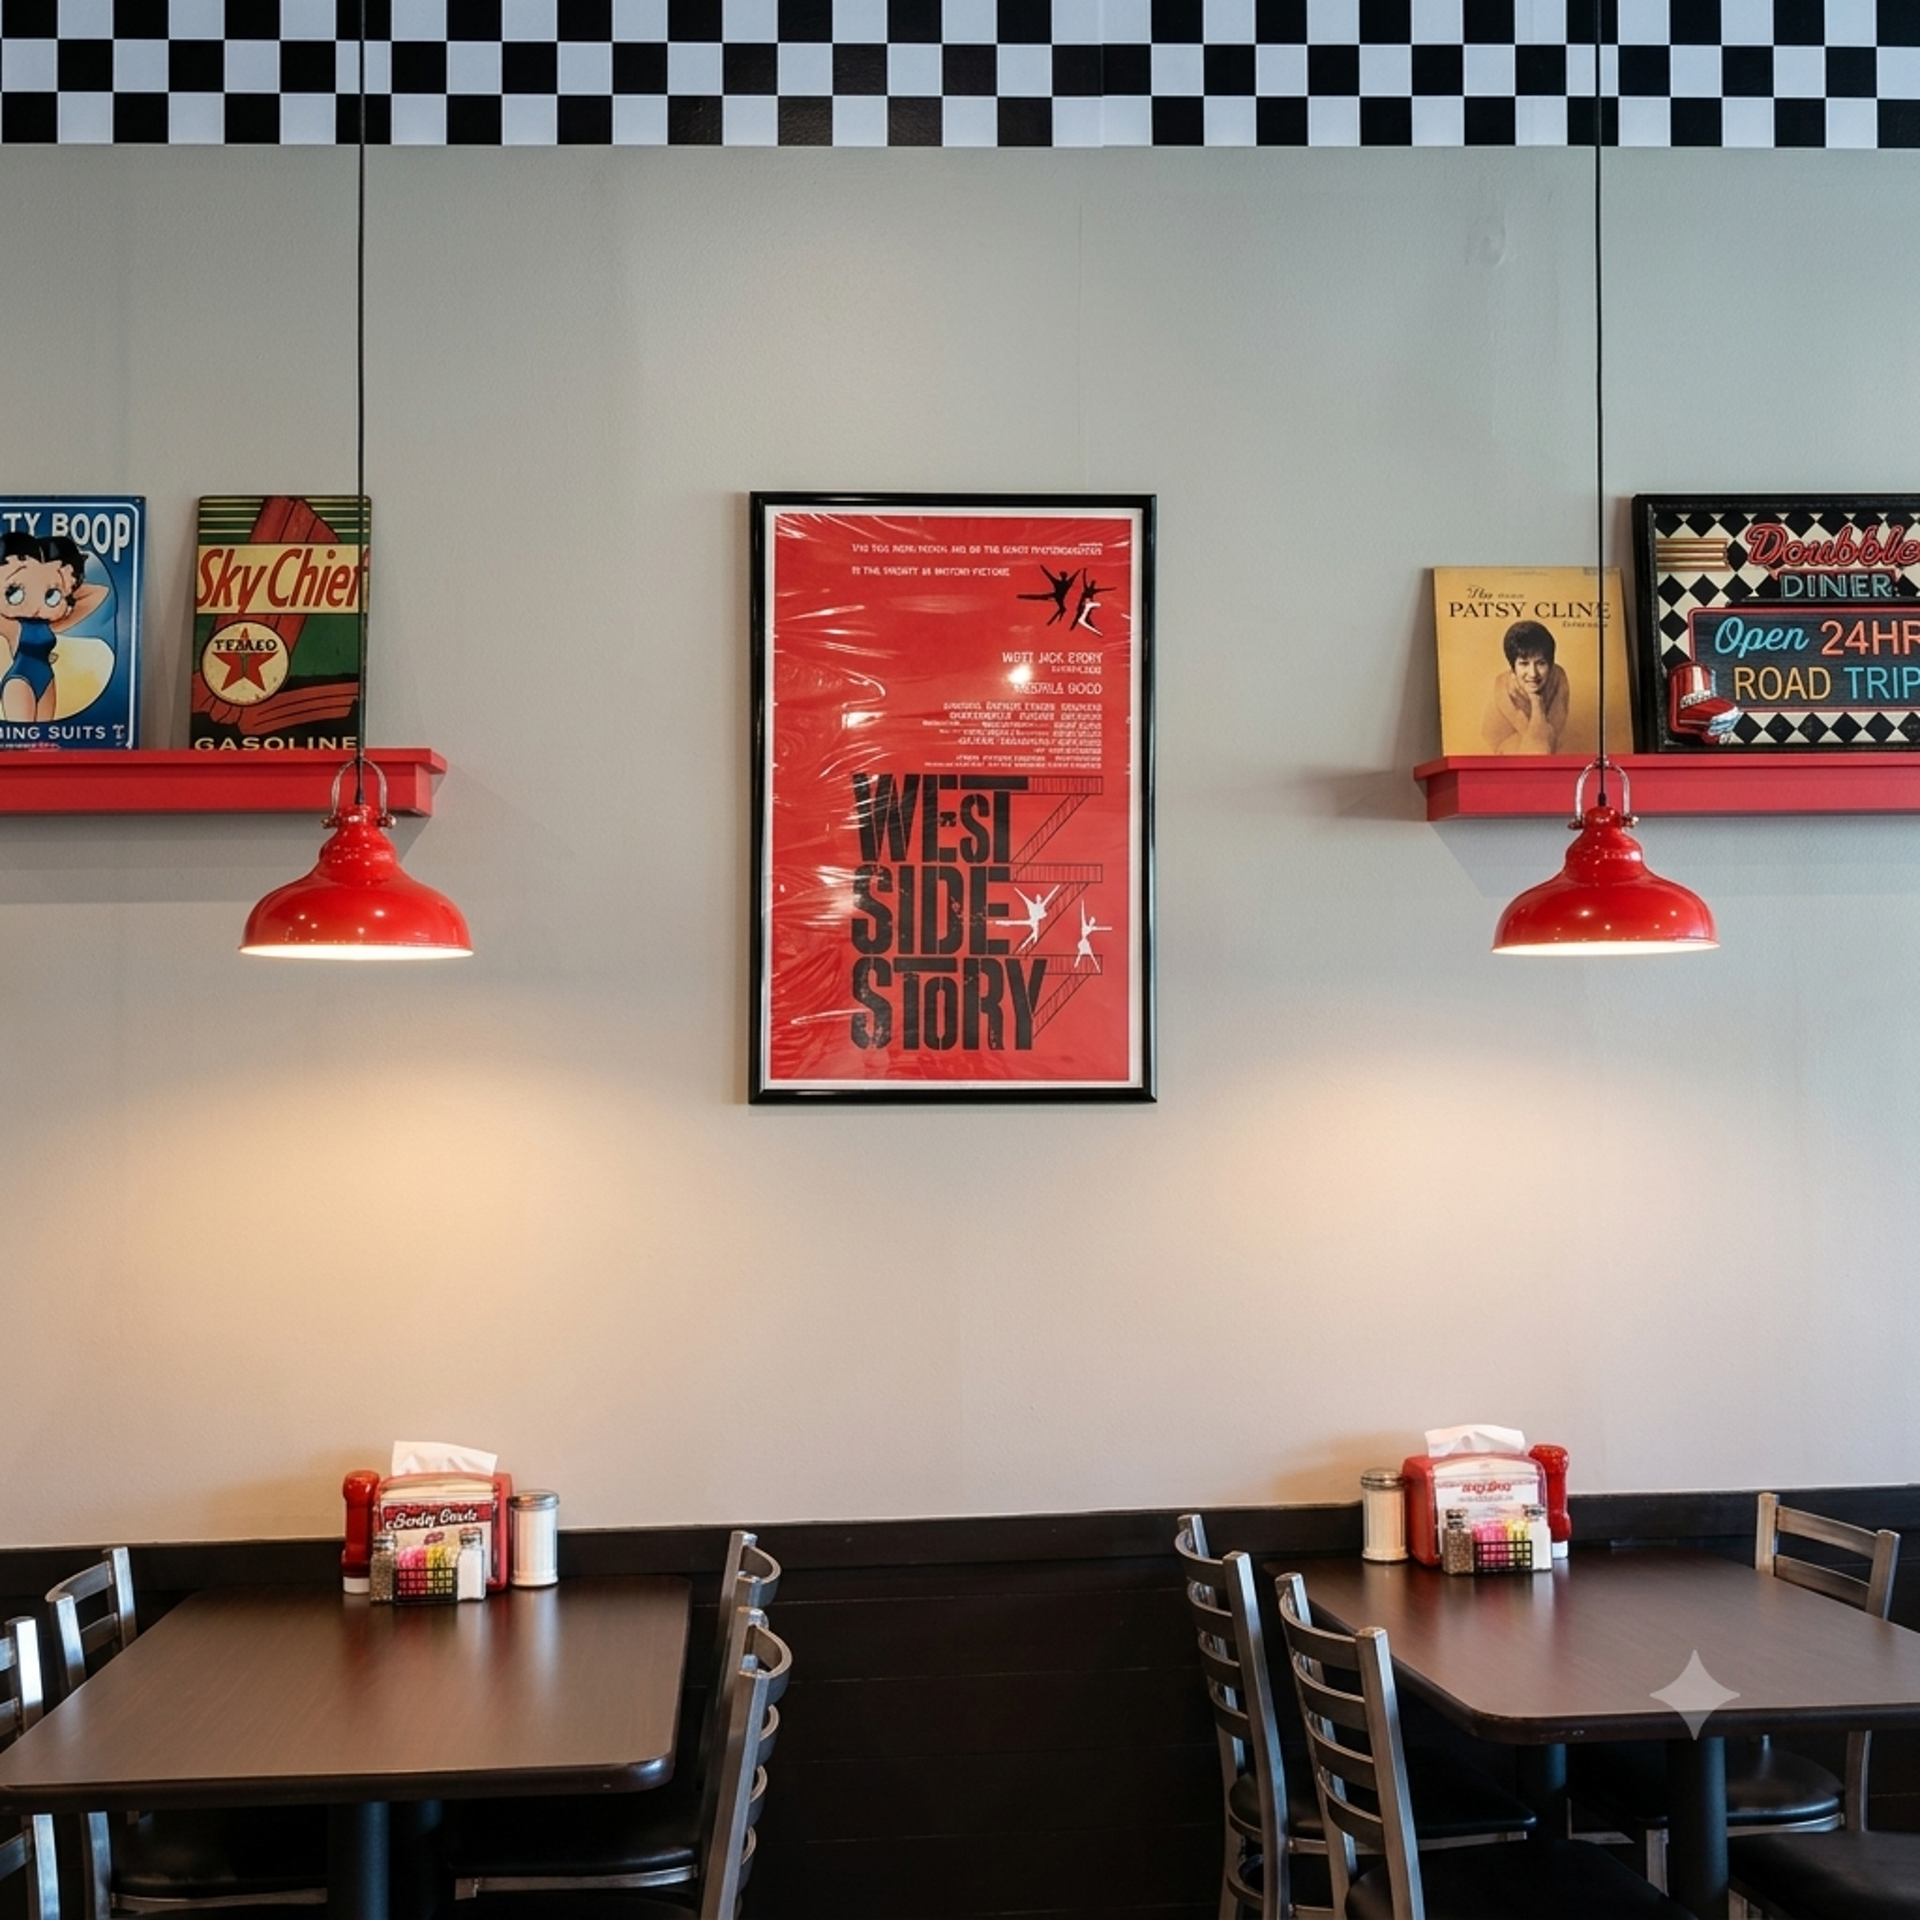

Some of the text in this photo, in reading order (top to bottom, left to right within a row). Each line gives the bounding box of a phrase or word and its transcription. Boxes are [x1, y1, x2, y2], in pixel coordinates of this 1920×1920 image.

[51, 513, 130, 563] BOOP
[197, 547, 370, 615] Sky Chief
[1449, 601, 1611, 619] PATSY CLINE
[1714, 616, 1809, 659] Open
[1734, 667, 1920, 700] ROAD TRIP
[48, 726, 106, 740] SUITS
[194, 736, 357, 751] GASOLINE
[853, 774, 1028, 863] WEST
[851, 864, 1010, 955] SIDE
[851, 956, 1047, 1051] STORY
